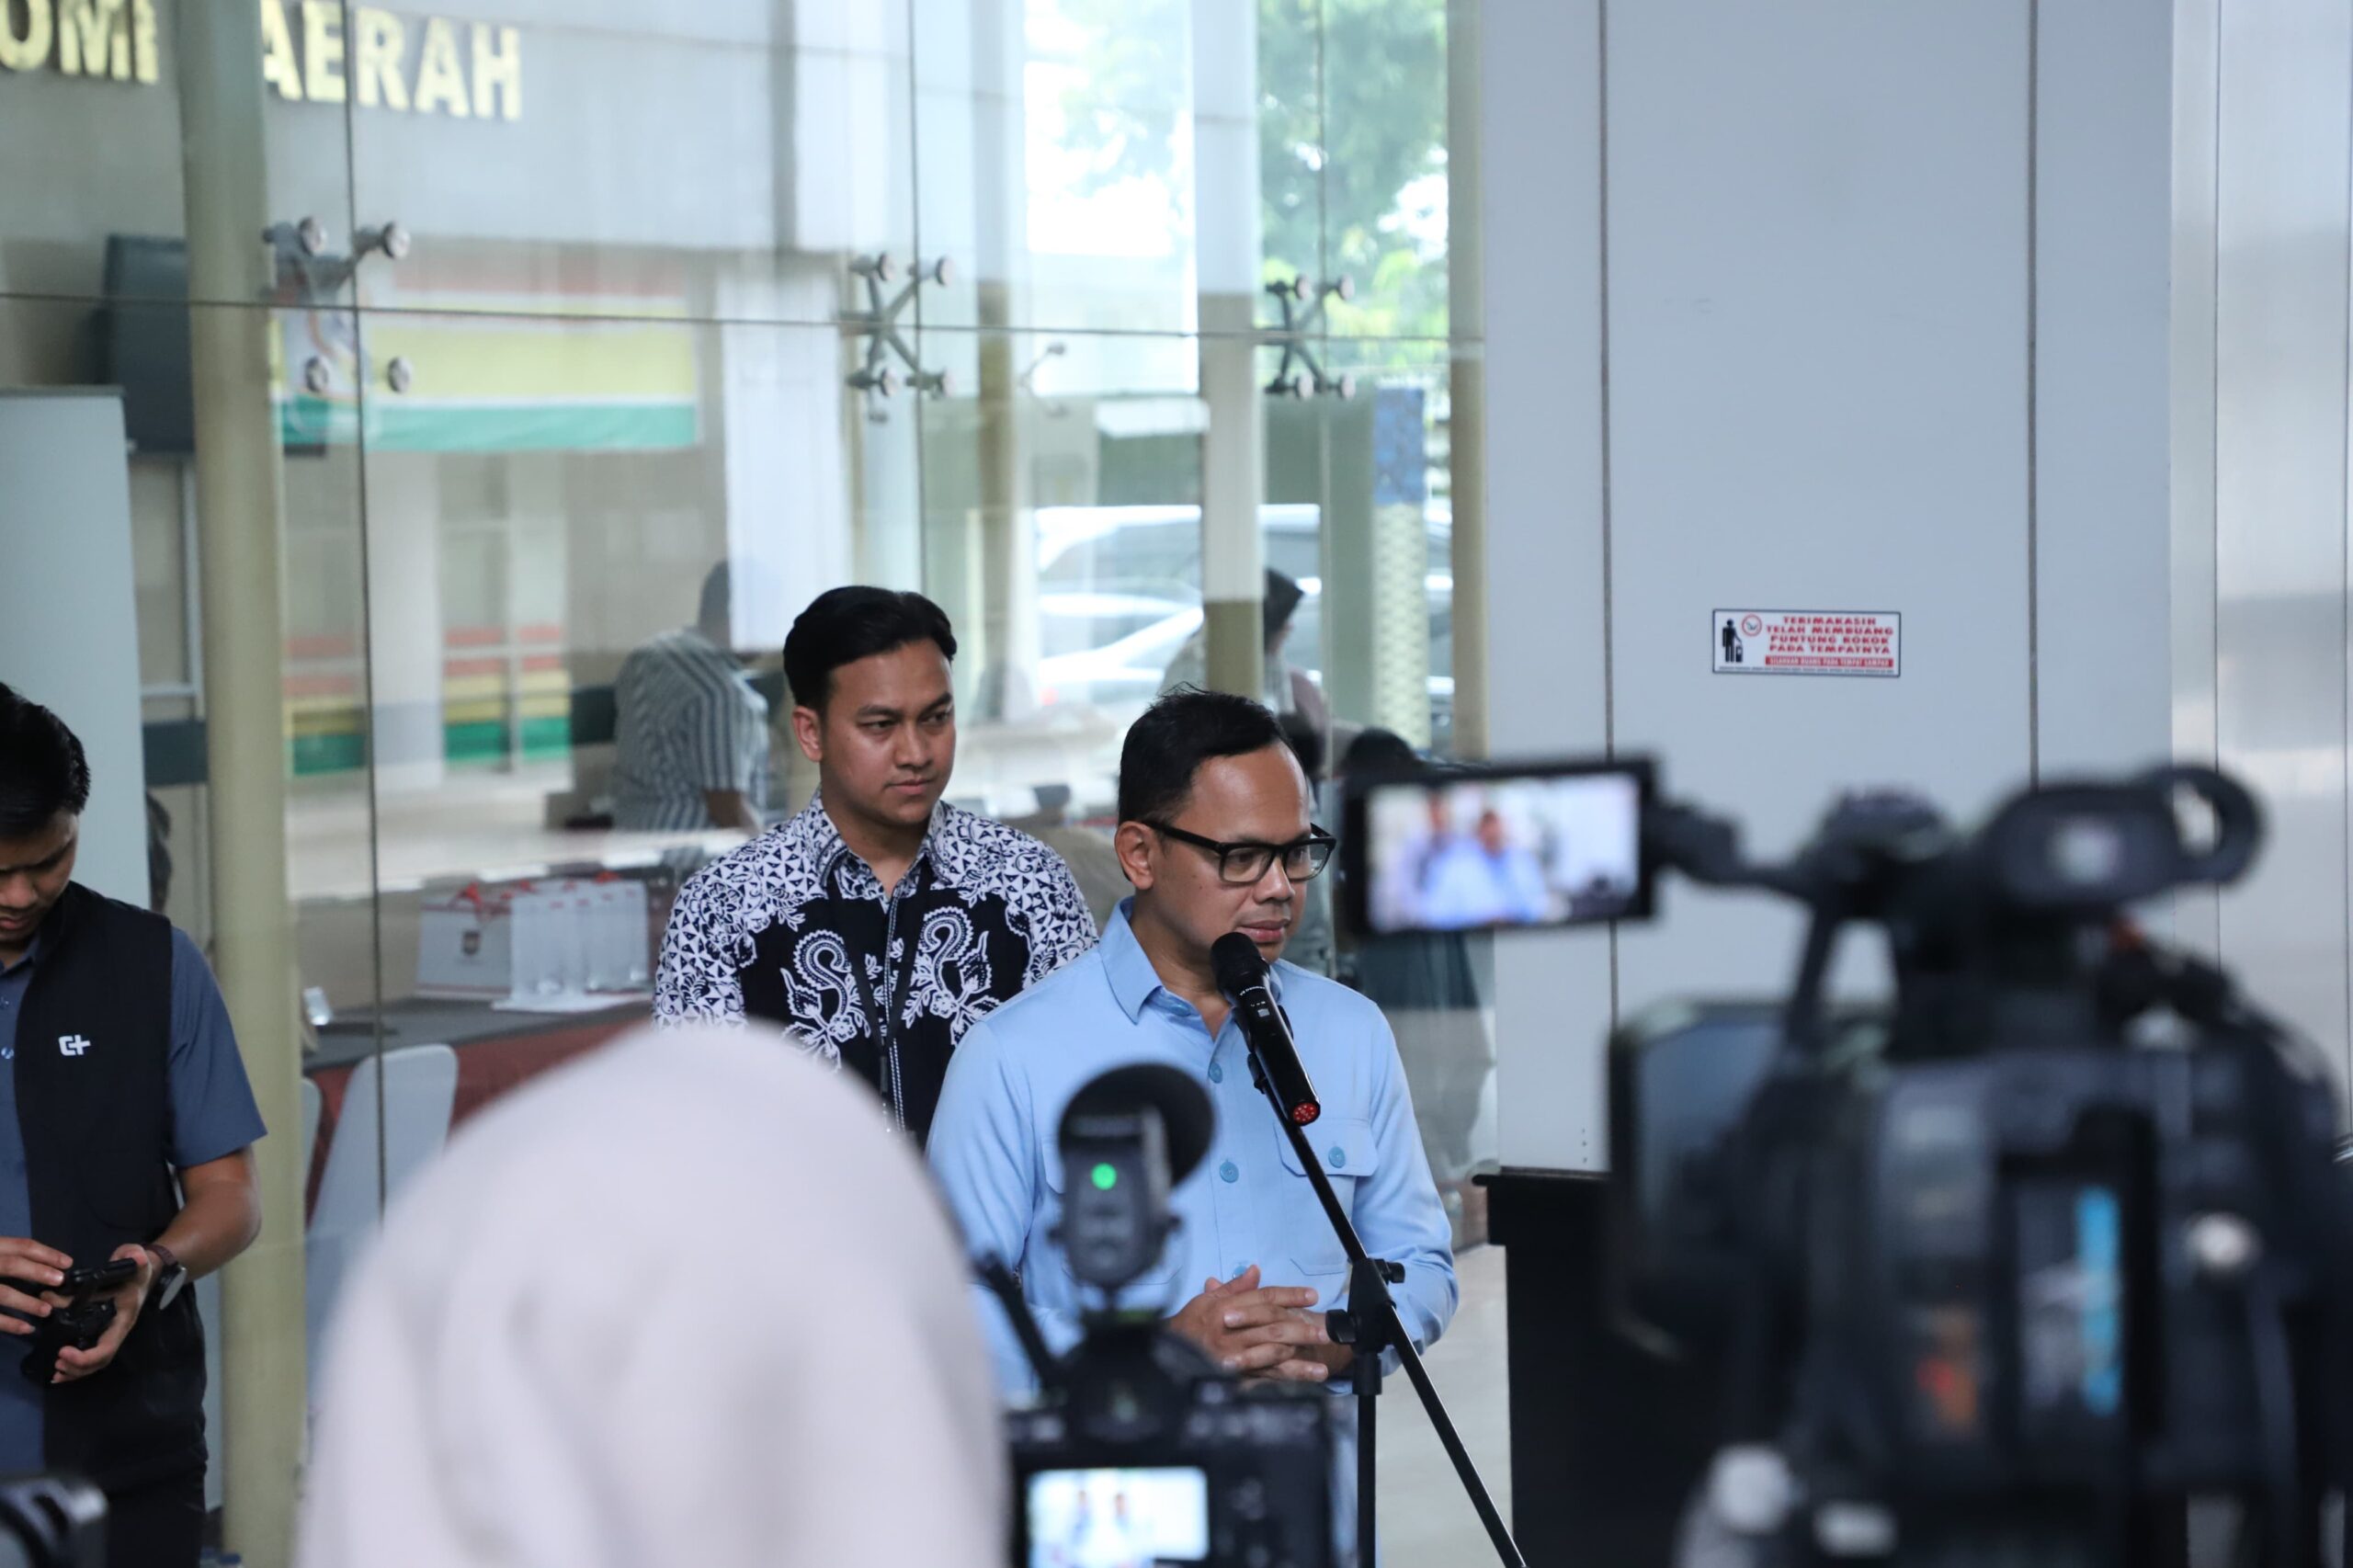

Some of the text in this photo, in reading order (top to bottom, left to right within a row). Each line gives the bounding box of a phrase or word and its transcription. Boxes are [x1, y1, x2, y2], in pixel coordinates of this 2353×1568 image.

[261, 0, 523, 120] AERAH
[1783, 616, 1876, 625] TERIMAKASIH
[1767, 625, 1893, 635] TELAH MEMBUANG
[1770, 635, 1888, 644] PUNTUNG ROKOK
[1769, 644, 1890, 653] PADA TEMPATNYA
